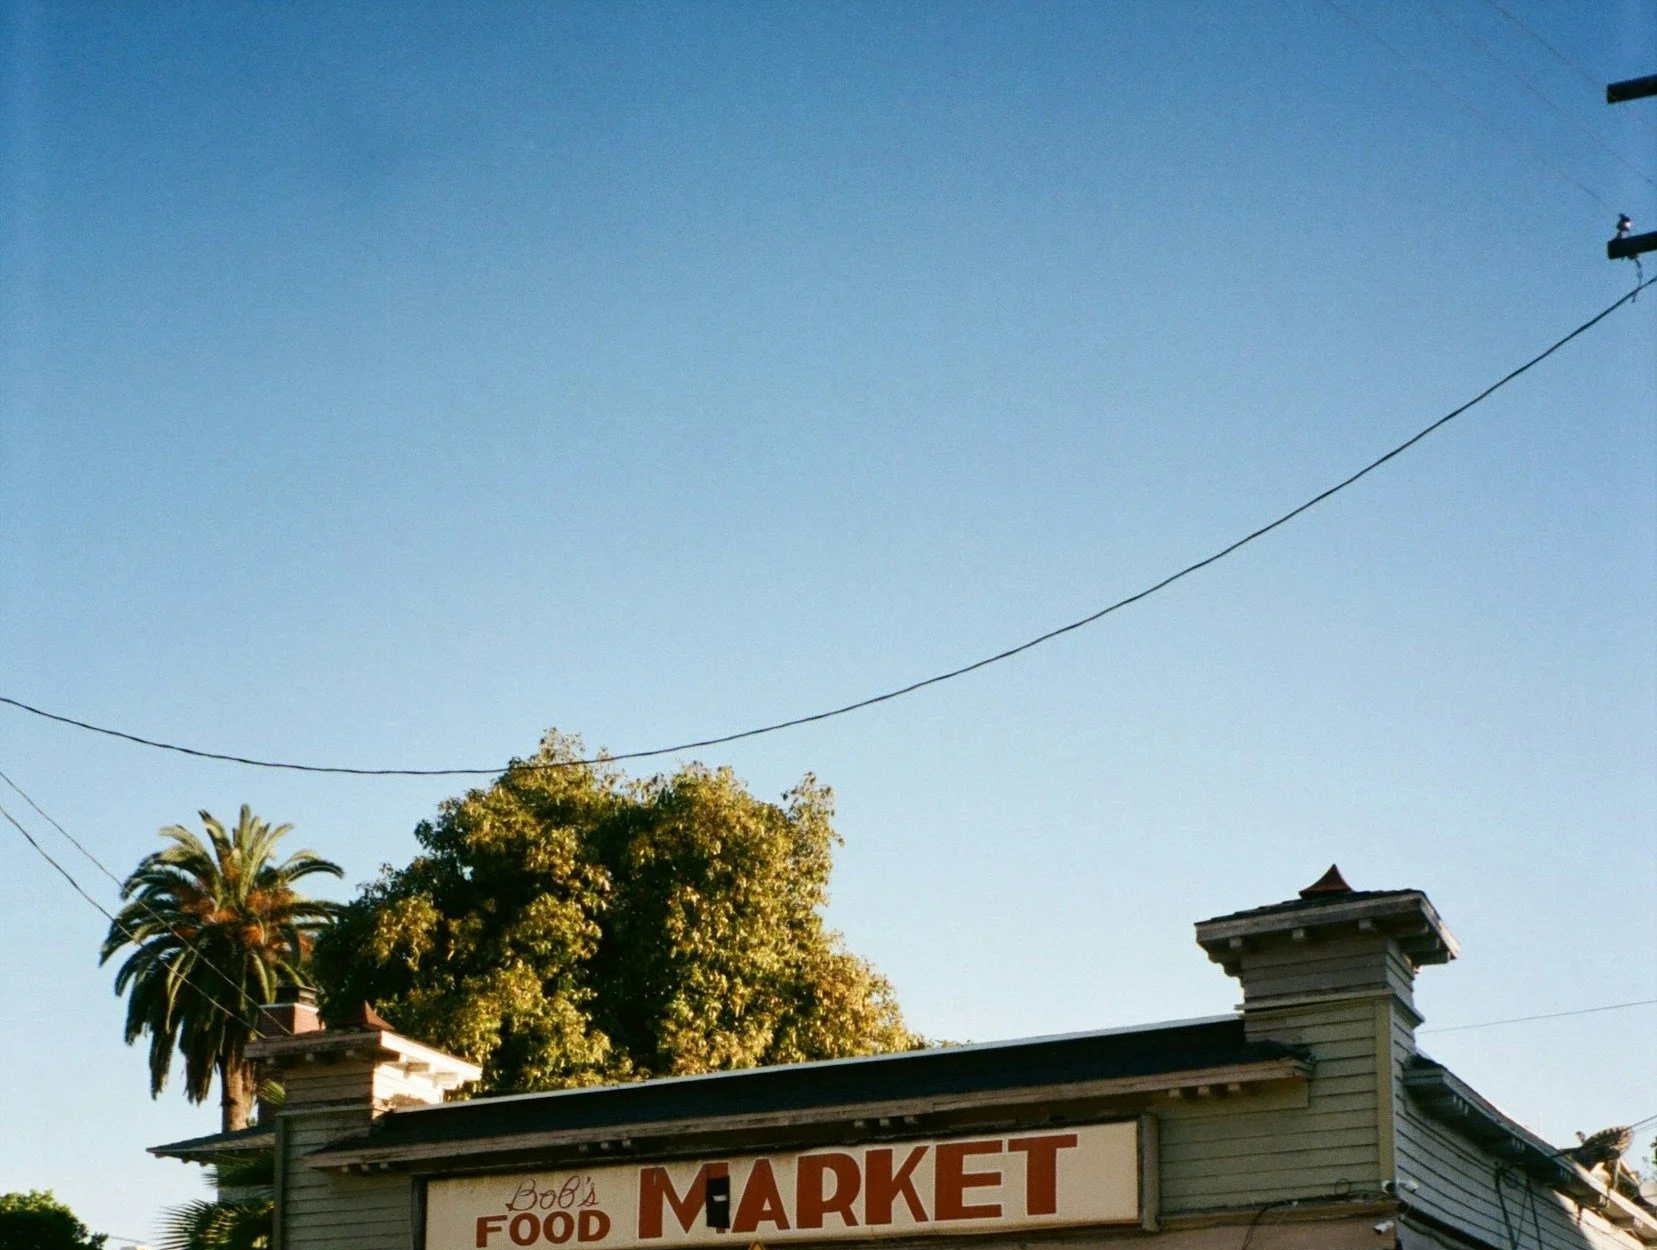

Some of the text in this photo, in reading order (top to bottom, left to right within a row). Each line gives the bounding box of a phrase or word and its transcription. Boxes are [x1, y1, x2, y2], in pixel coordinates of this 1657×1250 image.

[505, 1176, 599, 1213] Bob's
[638, 1134, 1078, 1240] MARKET
[476, 1209, 611, 1248] FOOD
